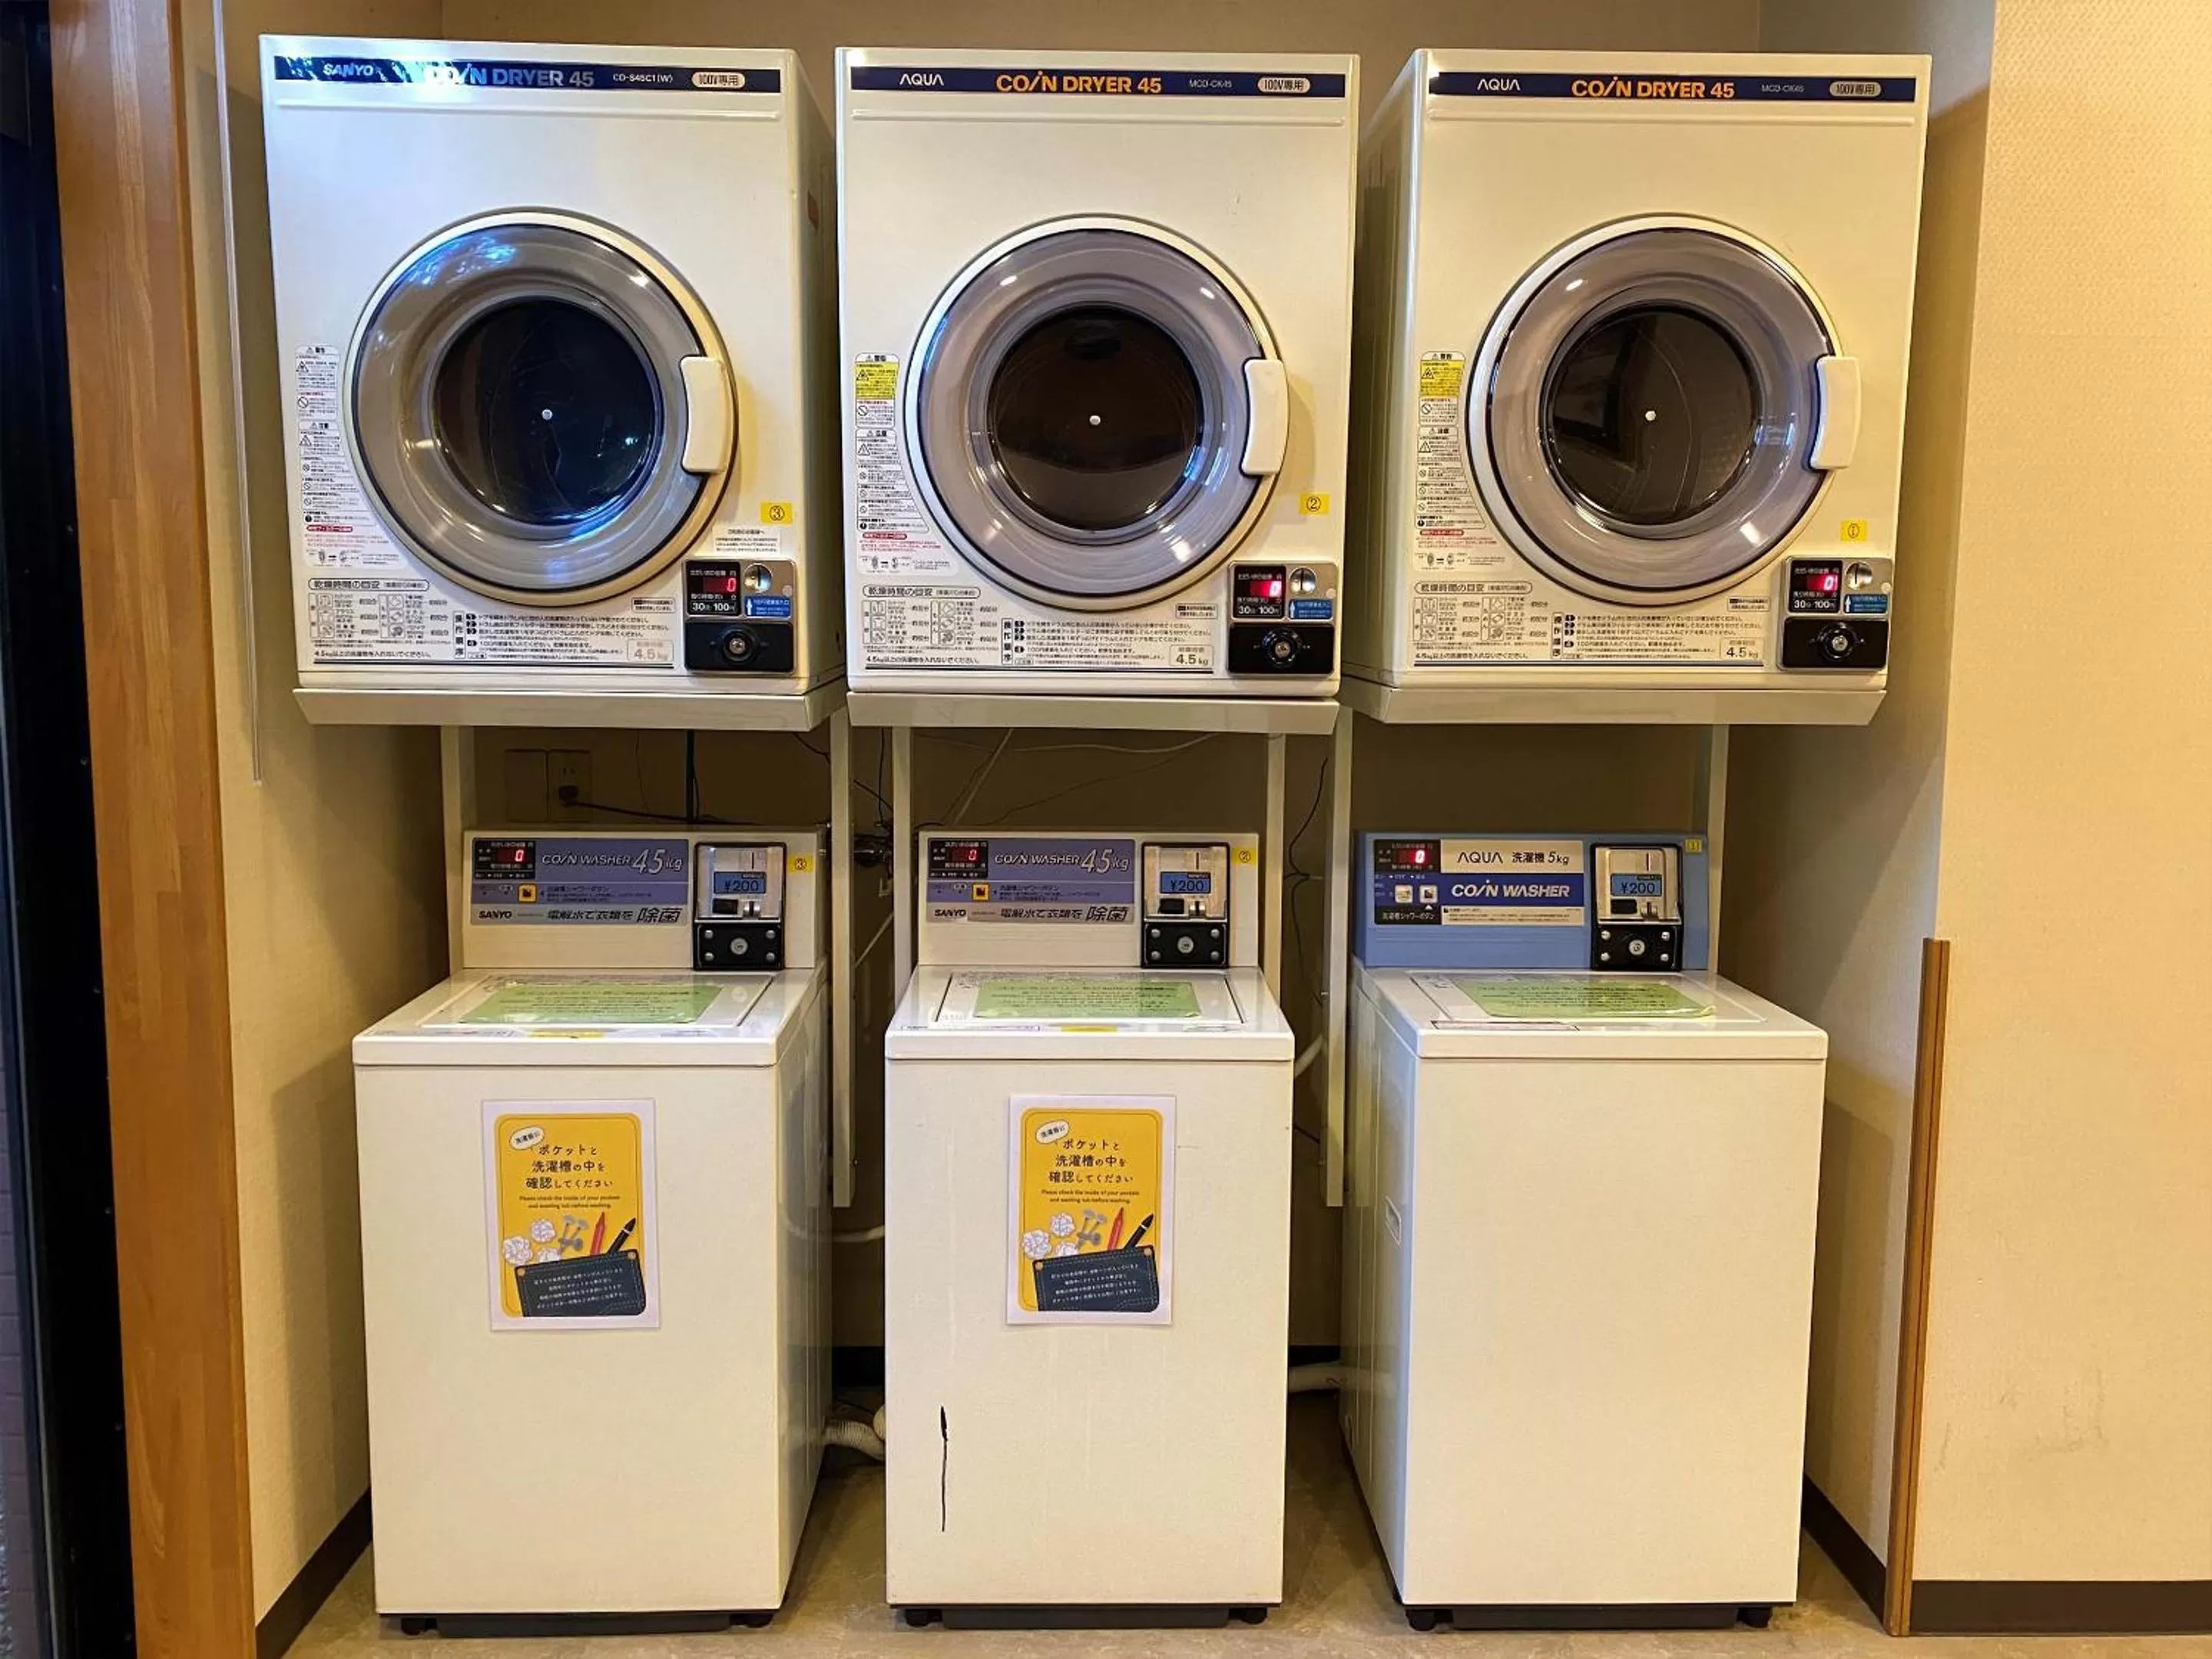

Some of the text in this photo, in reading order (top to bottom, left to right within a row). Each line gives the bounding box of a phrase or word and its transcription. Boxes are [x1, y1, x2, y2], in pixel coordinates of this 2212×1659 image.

[323, 62, 375, 77] SANYO
[492, 69, 562, 87] DRYER
[568, 71, 594, 88] 45
[899, 73, 945, 87] AQUA
[1062, 75, 1132, 94] DRYER
[1137, 77, 1162, 94] 45
[1477, 78, 1522, 91] AQUA
[1636, 81, 1705, 98] DRYER
[1710, 82, 1735, 98] 45
[515, 849, 525, 862] 0
[579, 854, 631, 866] WASHER
[1031, 854, 1079, 865] WASHER
[1457, 852, 1503, 864] AQUA
[1512, 851, 1570, 865] 洗濯機 5kg
[1503, 885, 1570, 898] WASHER
[478, 910, 512, 919] SANYO
[636, 907, 683, 923] 除菌
[934, 909, 967, 918] SANYO
[1084, 906, 1130, 922] 除菌
[538, 1144, 597, 1155] ポケットと
[1062, 1138, 1119, 1151] ポケットと
[531, 1160, 606, 1174] 洗濯槽の中を
[1055, 1154, 1128, 1167] 洗濯槽の中を
[525, 1176, 614, 1190] 確認してください
[1048, 1171, 1134, 1184] 確認してください
